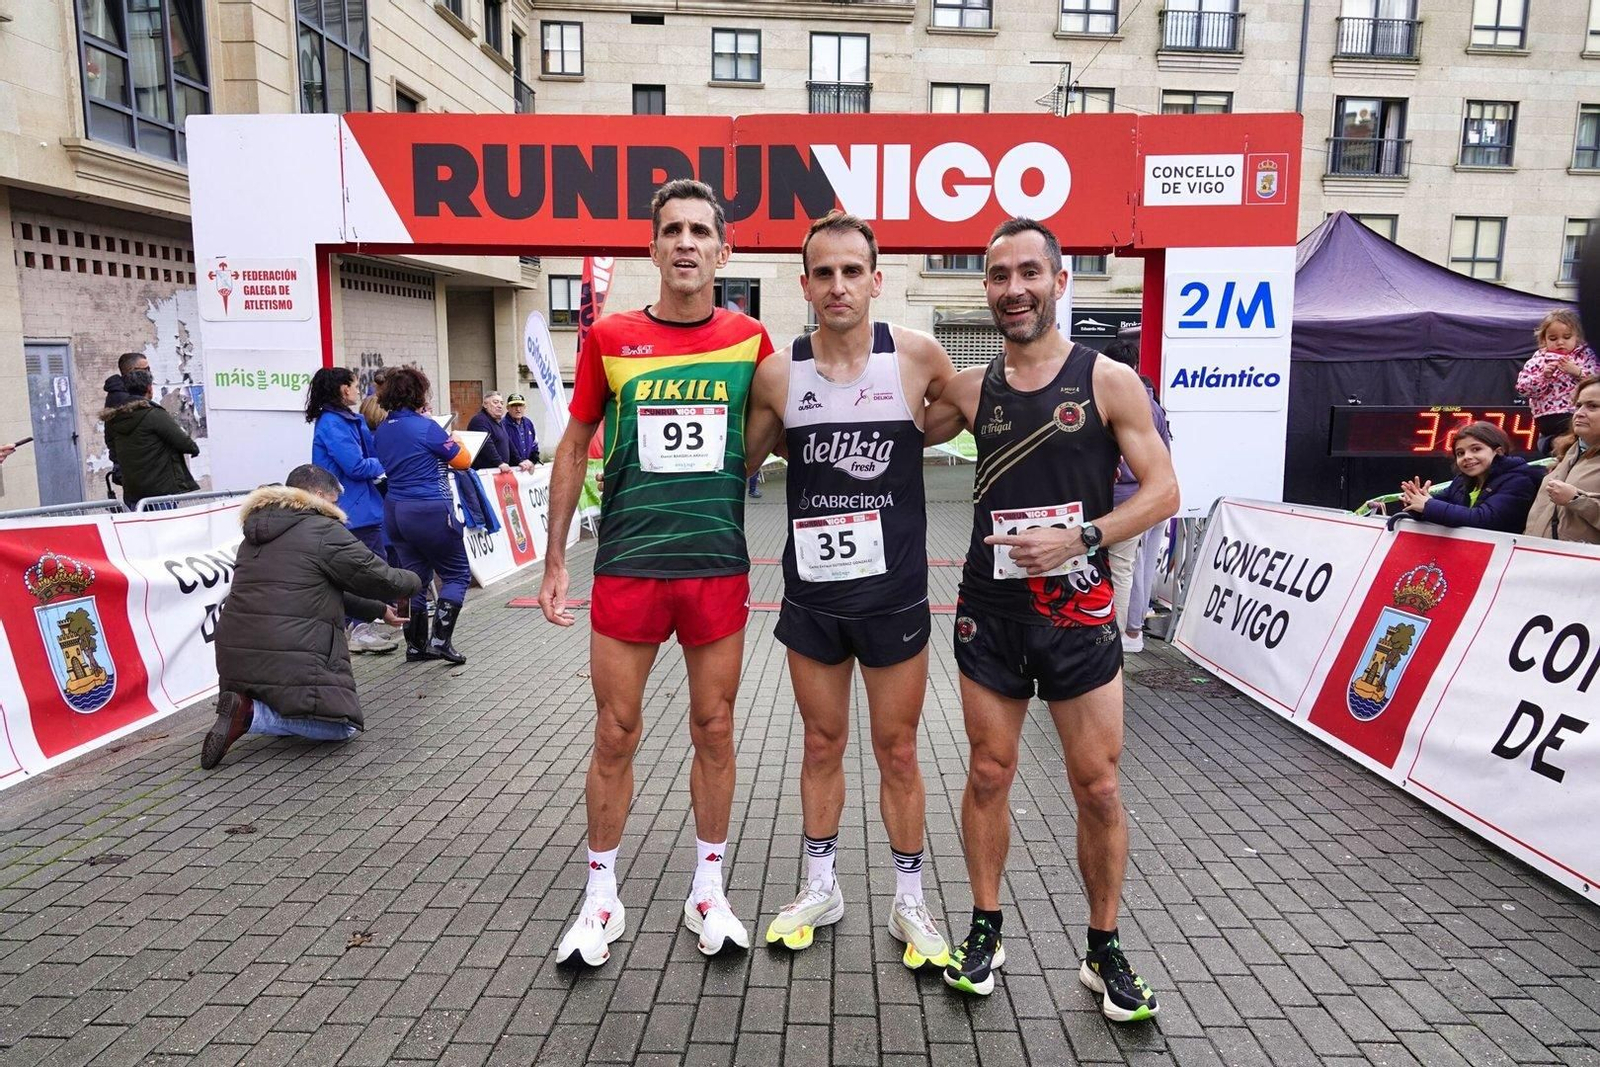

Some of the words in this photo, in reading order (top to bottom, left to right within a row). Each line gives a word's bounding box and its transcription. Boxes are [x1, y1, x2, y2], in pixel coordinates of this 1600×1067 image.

[1152, 165, 1235, 179] CONCELLO
[1161, 182, 1181, 195] DE
[1187, 181, 1225, 194] VIGO
[242, 268, 297, 281] FEDERACIÓN
[243, 285, 277, 296] GALEGA
[278, 285, 290, 296] DE
[244, 299, 293, 310] ATLETISMO
[215, 368, 255, 387] máis
[270, 373, 310, 391] auga
[1170, 366, 1281, 389] Atlántico
[634, 379, 730, 402] BIKILA
[662, 421, 704, 452] 93
[987, 421, 1012, 435] Trigal
[803, 431, 894, 465] delikia
[851, 461, 876, 472] fresh
[811, 491, 894, 509] CABREIROÁ
[467, 530, 494, 559] VIGO
[817, 529, 857, 561] 35
[1213, 536, 1333, 602] CONCELLO
[1203, 584, 1234, 625] DE
[1230, 593, 1290, 649] VIGO
[1490, 699, 1590, 784] DE
